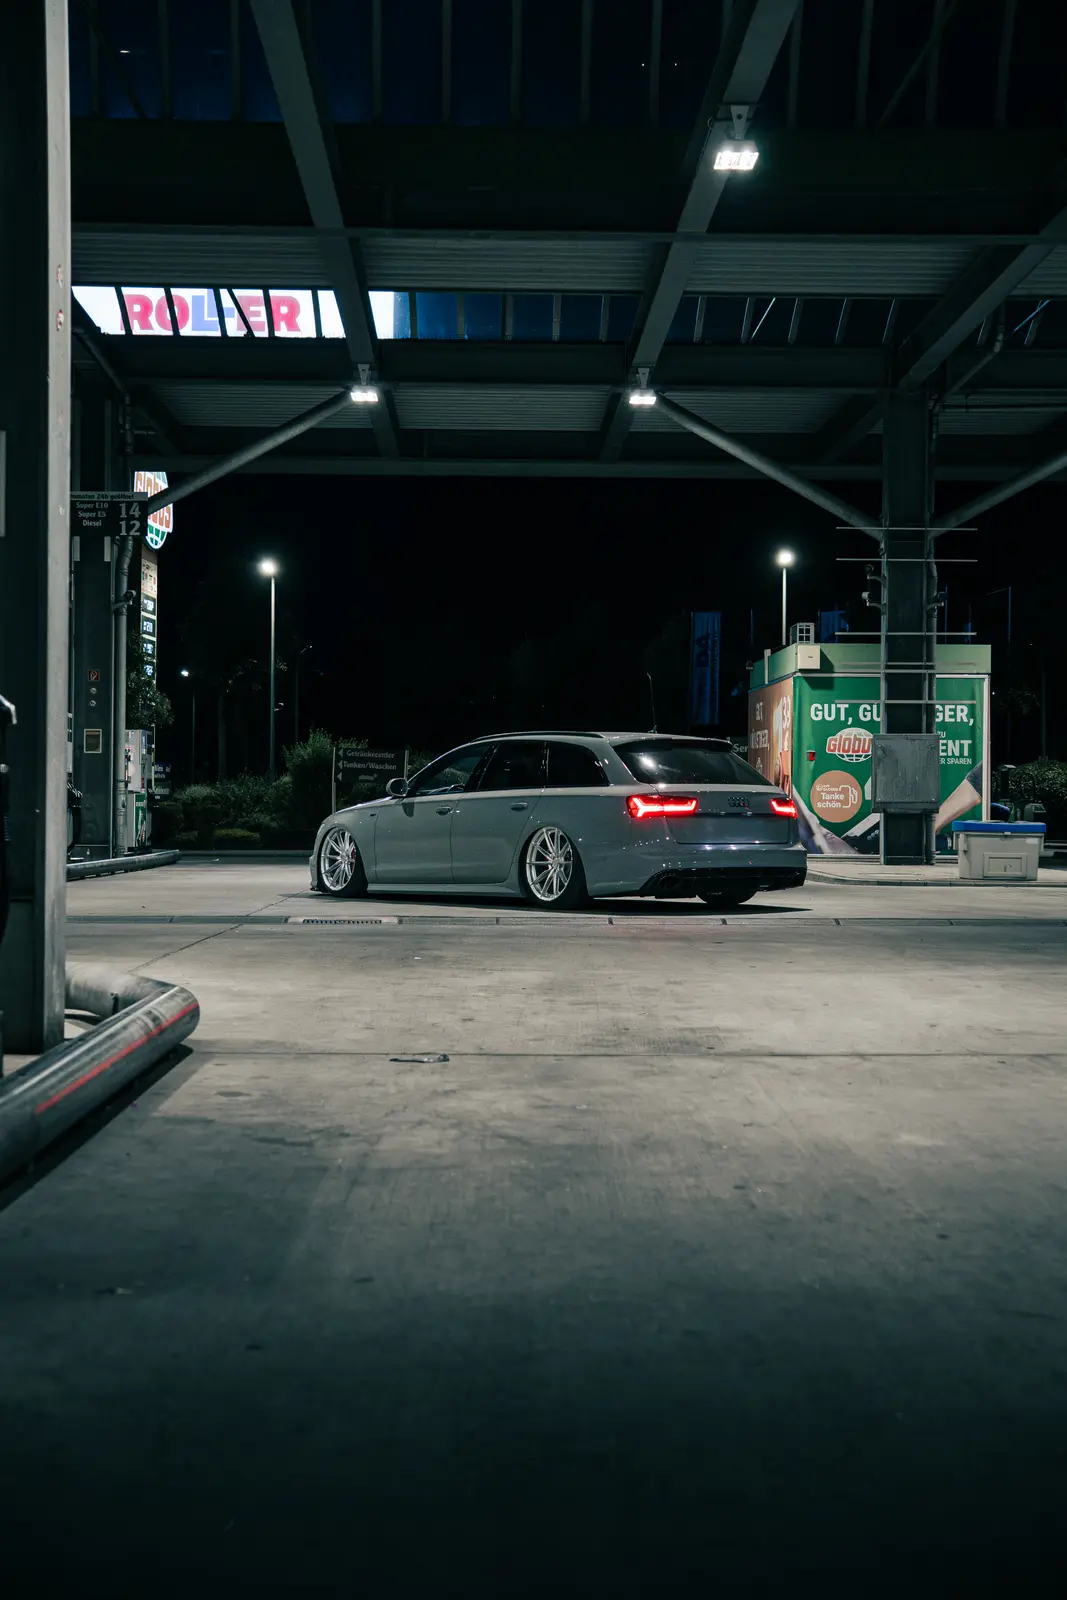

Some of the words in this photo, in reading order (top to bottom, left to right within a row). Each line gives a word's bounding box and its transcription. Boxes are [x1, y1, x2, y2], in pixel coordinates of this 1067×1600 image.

[121, 292, 301, 332] ROLLER
[76, 501, 94, 510] Super
[119, 502, 141, 518] 14
[78, 511, 96, 519] Super
[82, 519, 102, 527] Diesel
[119, 520, 141, 536] 12
[810, 704, 853, 725] GUT,
[826, 735, 872, 754] Globu
[939, 740, 972, 756] ENT
[946, 757, 972, 765] SPAREN
[821, 792, 845, 800] Tanke
[816, 800, 842, 808] schön
